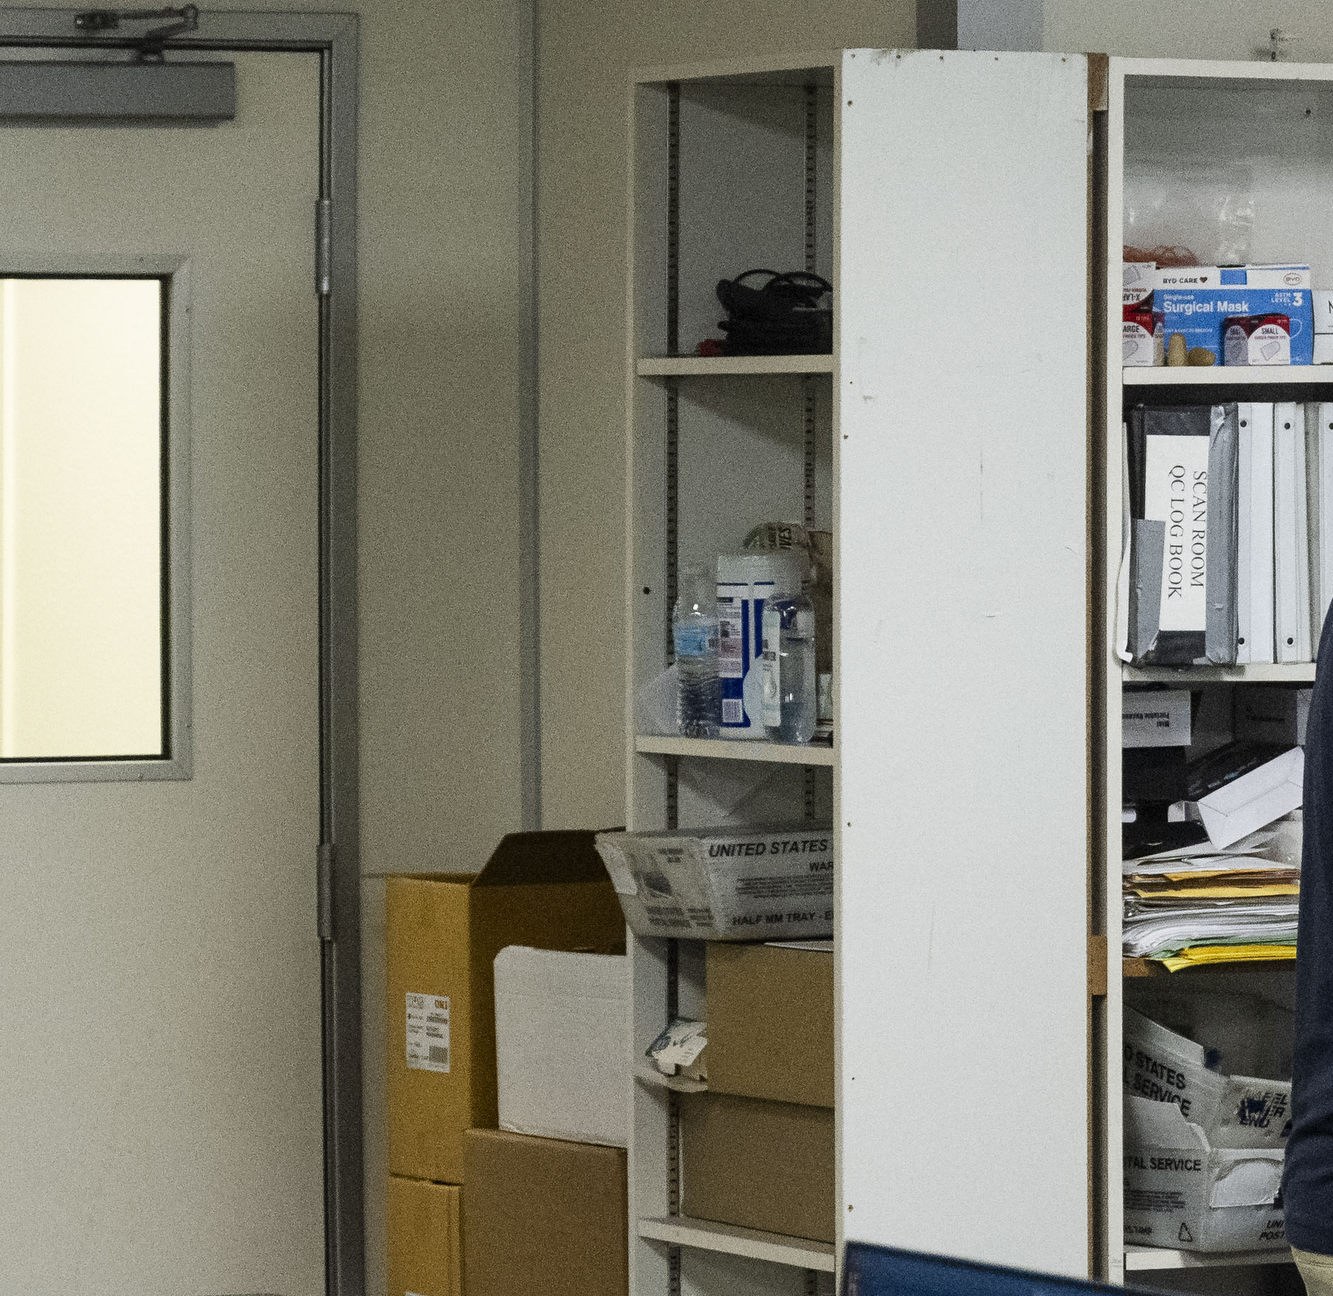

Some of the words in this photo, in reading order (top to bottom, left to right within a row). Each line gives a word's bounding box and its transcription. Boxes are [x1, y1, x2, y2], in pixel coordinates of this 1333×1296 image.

[1163, 301, 1214, 315] Surgical
[1217, 301, 1249, 313] Mask
[1292, 292, 1303, 306] 3
[1168, 465, 1186, 491] QC
[1192, 470, 1207, 522] SCAN
[1169, 499, 1185, 538] LOG
[1168, 544, 1184, 598] BOOK
[1190, 528, 1206, 588] ROOM
[709, 843, 766, 857] UNITED
[770, 839, 828, 855] STATES
[786, 911, 816, 923] TRAY
[1136, 1052, 1187, 1091] STATES
[1150, 1158, 1202, 1172] SERVICE
